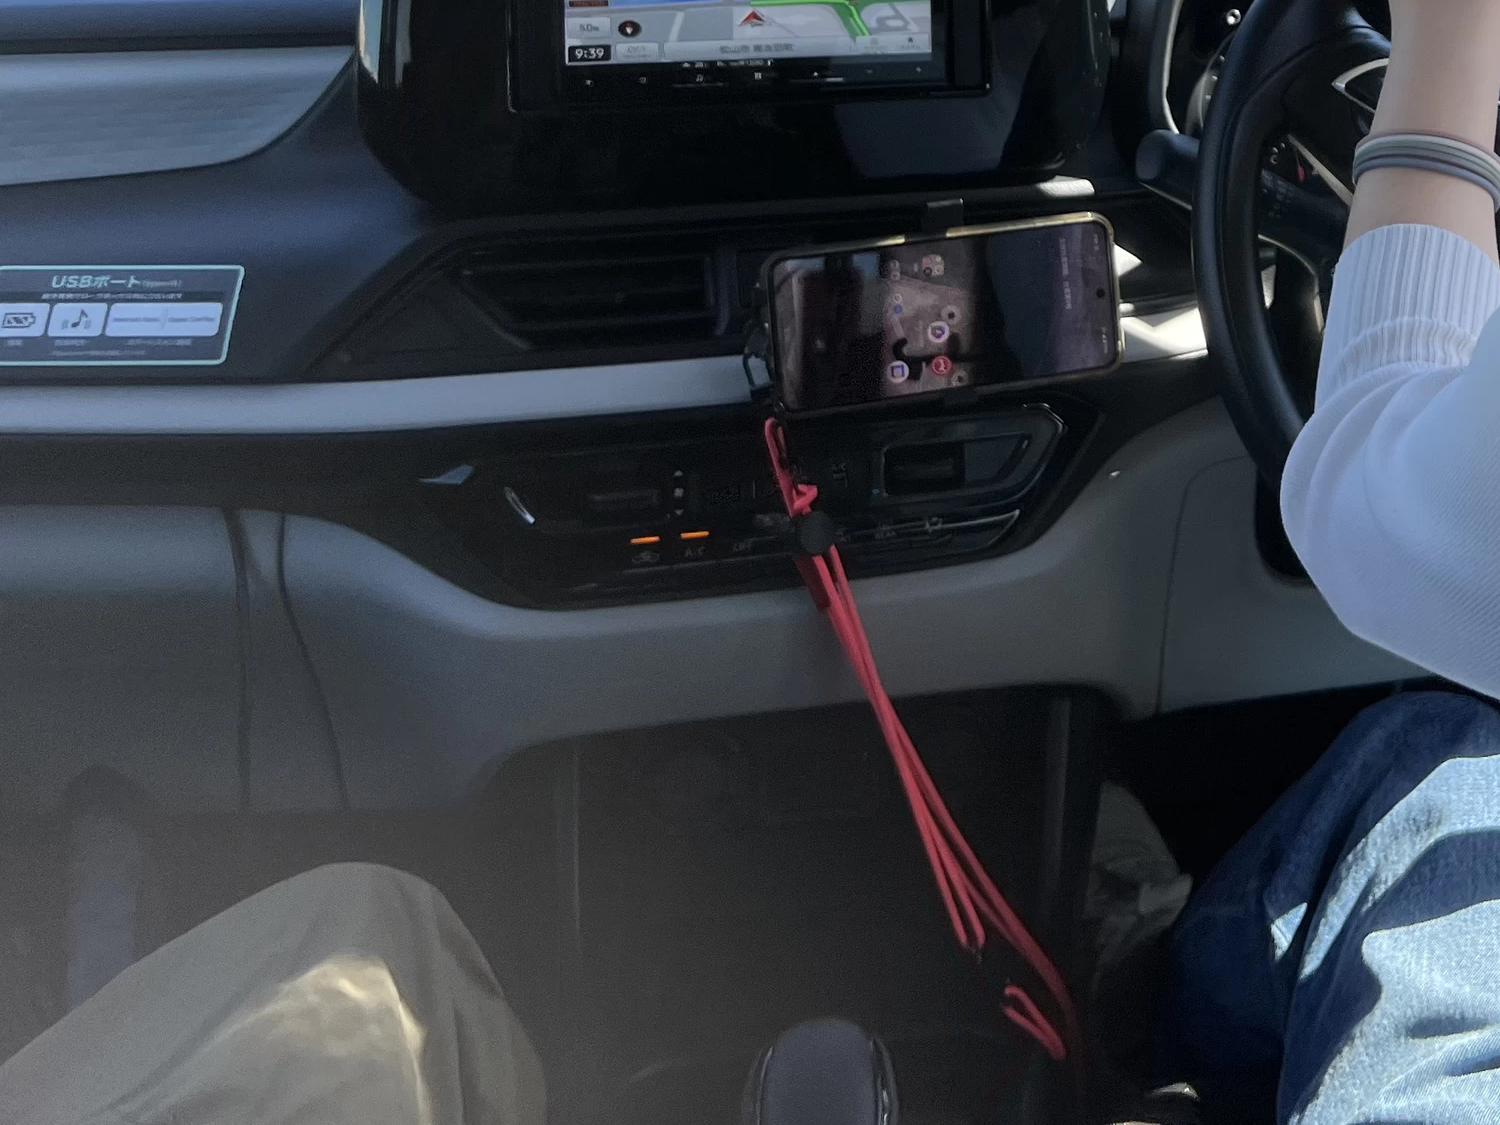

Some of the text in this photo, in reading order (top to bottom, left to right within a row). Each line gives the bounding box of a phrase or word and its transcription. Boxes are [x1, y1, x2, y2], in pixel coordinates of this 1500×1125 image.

[575, 48, 605, 60] 9:39
[51, 275, 141, 288] USBポート
